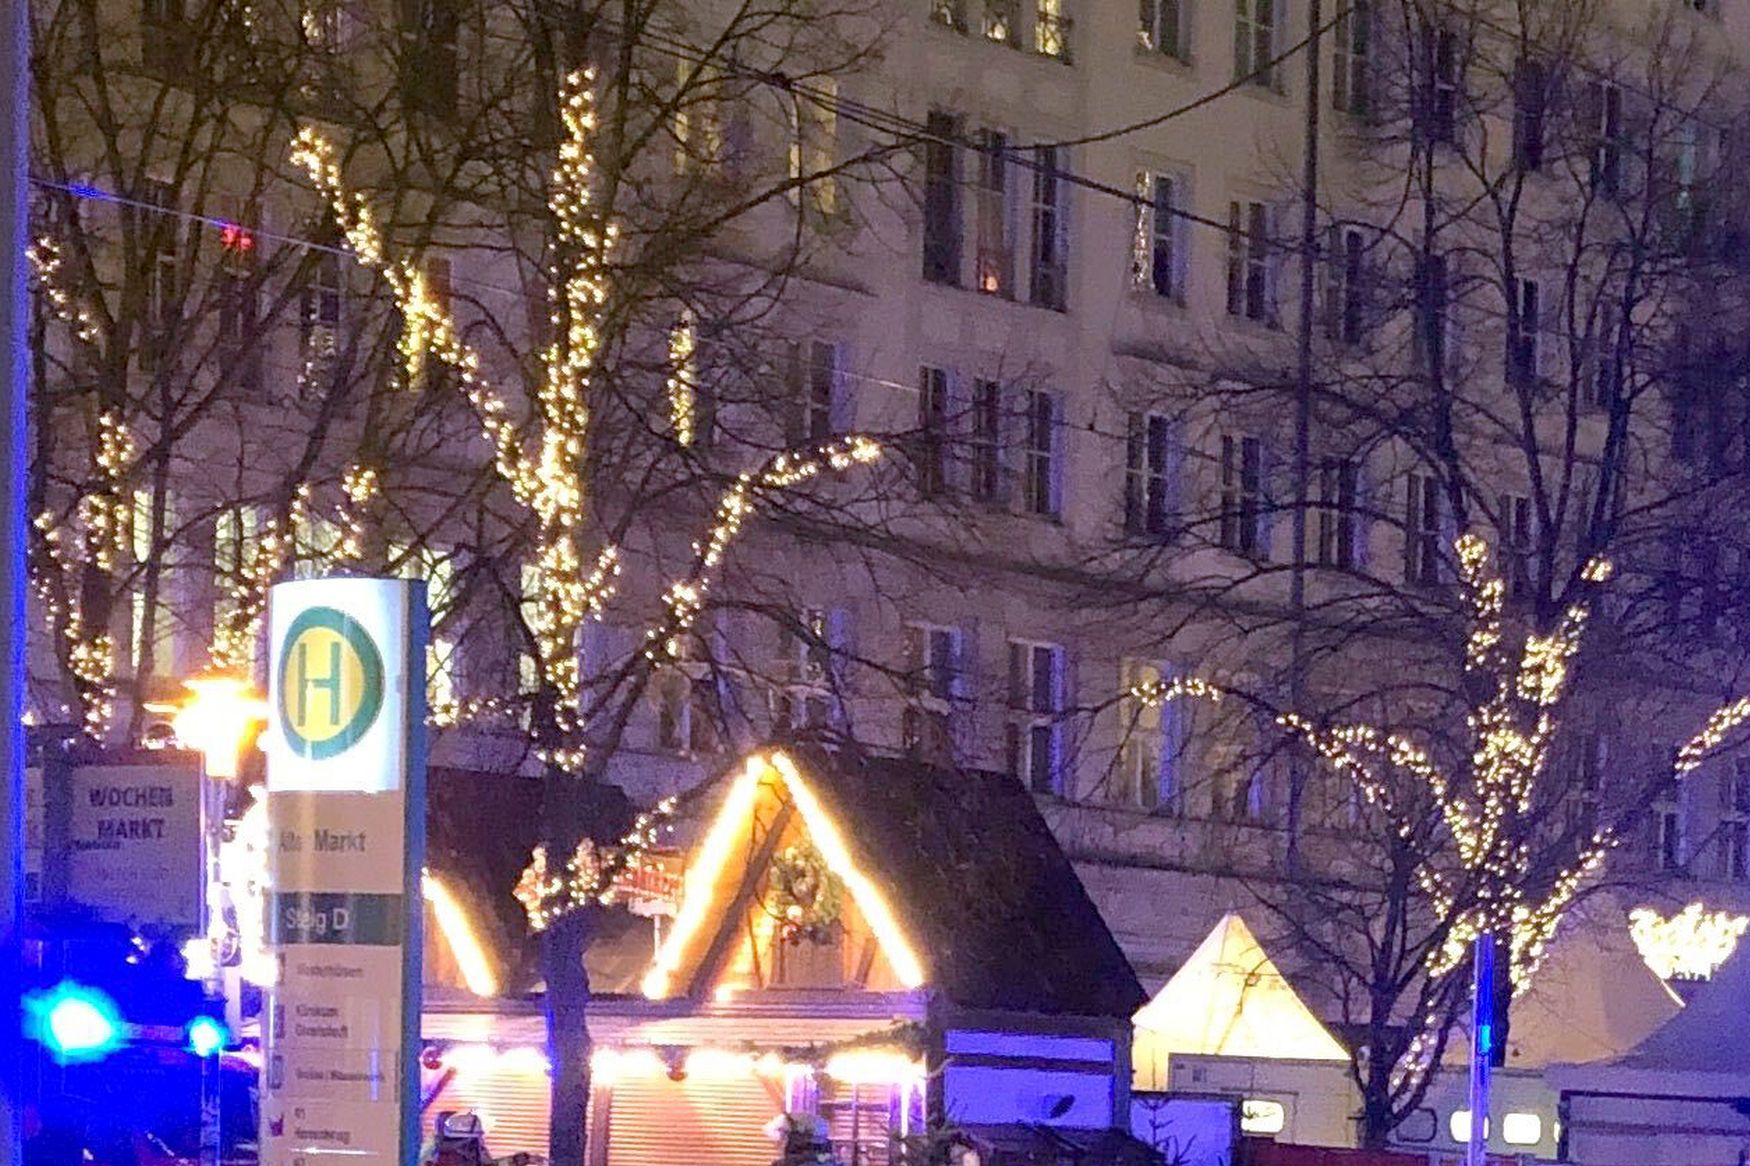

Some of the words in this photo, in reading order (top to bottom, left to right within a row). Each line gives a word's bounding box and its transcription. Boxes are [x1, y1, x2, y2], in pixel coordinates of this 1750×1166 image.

[296, 641, 341, 727] H
[97, 818, 165, 838] MARKT
[332, 908, 350, 929] D
